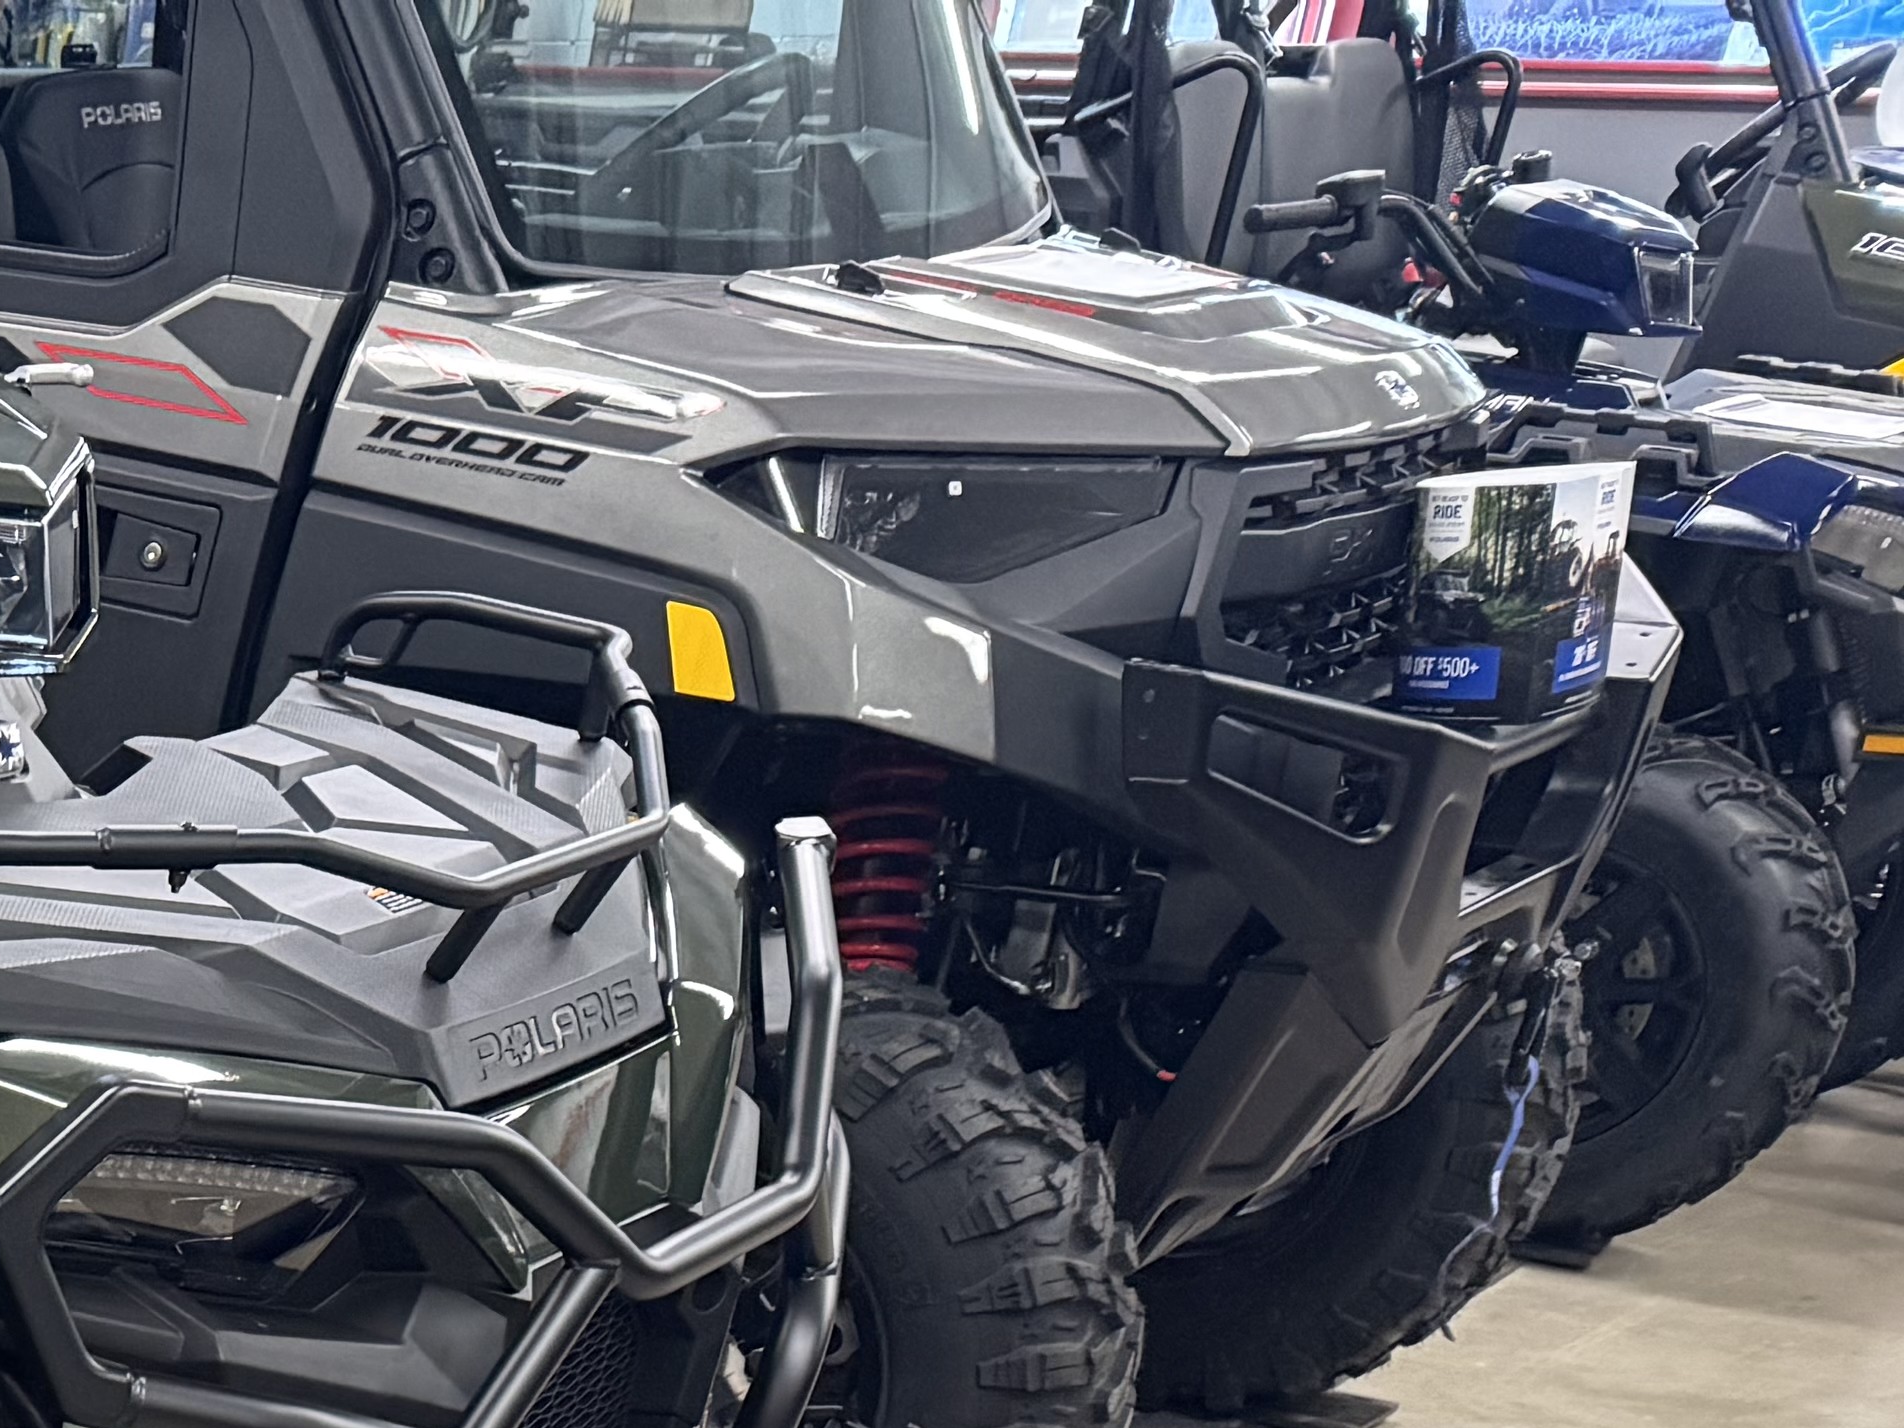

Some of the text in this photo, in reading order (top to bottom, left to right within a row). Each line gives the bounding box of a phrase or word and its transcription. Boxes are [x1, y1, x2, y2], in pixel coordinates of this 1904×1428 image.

[81, 102, 162, 128] POLARIS
[366, 414, 590, 473] 1000
[357, 443, 566, 486] DUAL OVERHEAD CAM
[1433, 504, 1462, 519] RIDE
[1413, 656, 1436, 676] OFF
[467, 977, 641, 1083] POLARIS
